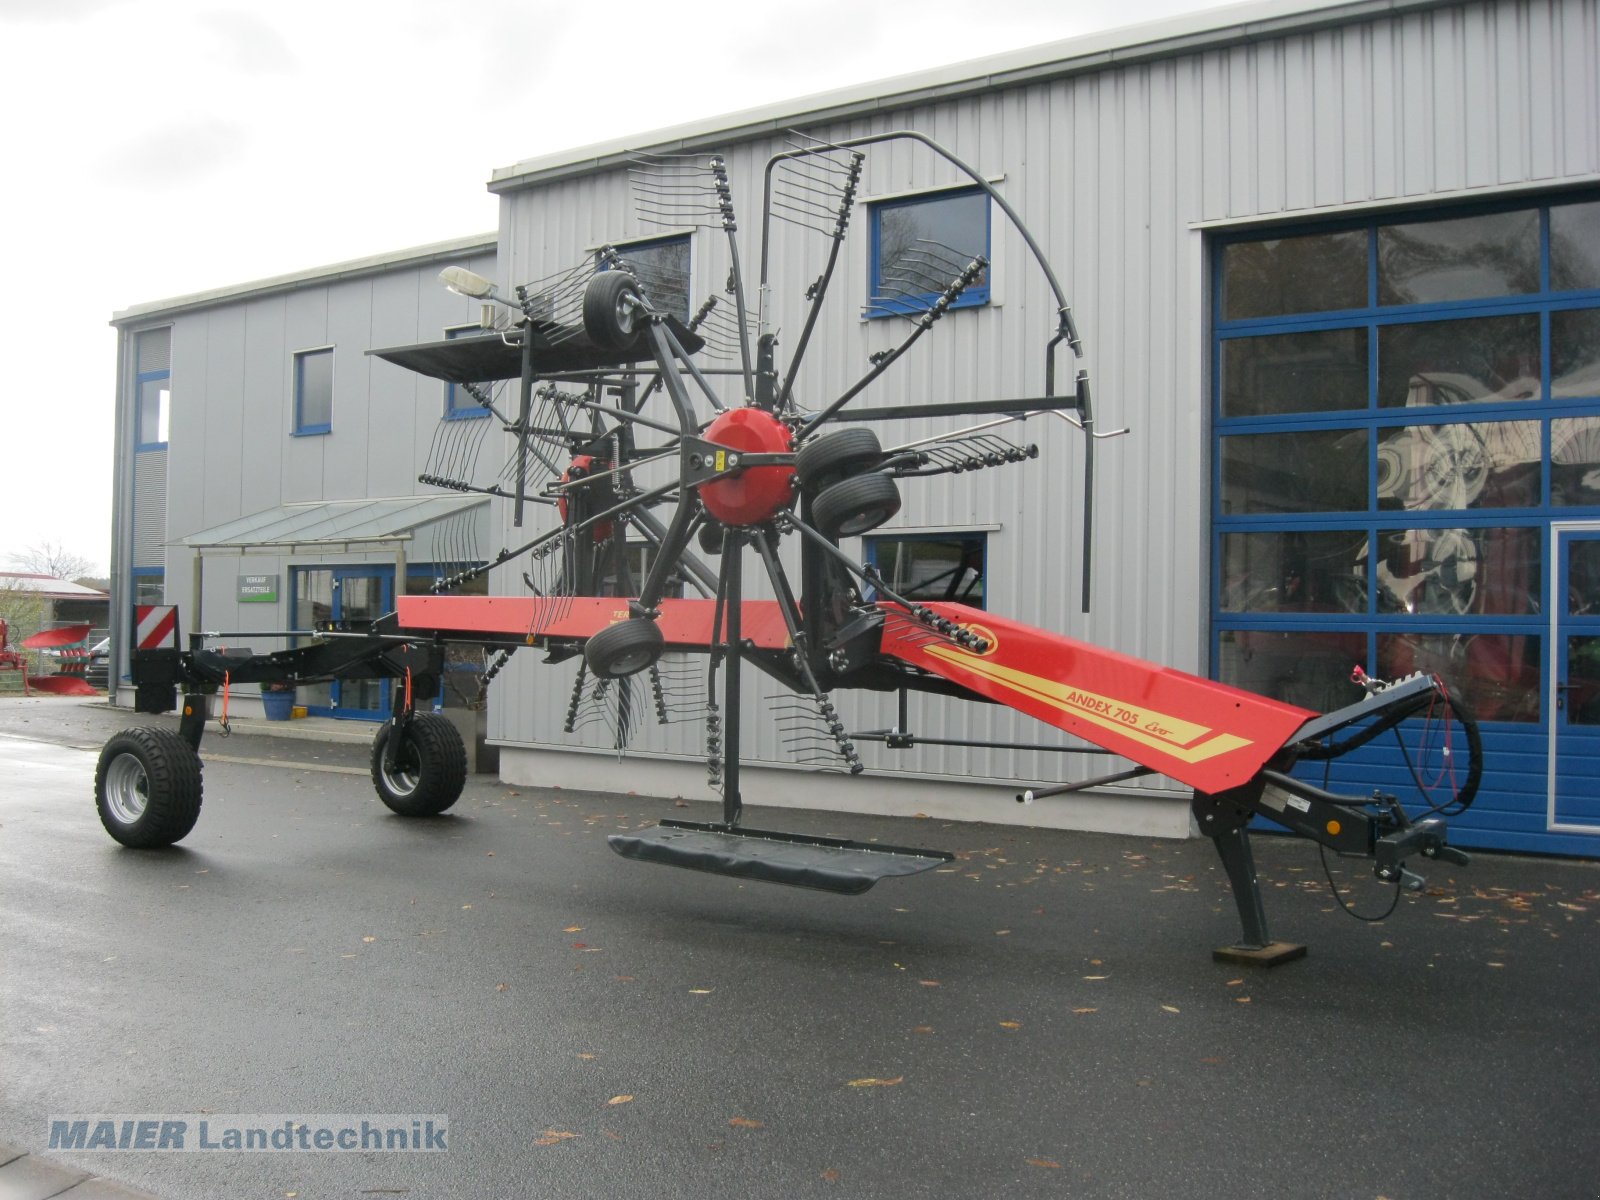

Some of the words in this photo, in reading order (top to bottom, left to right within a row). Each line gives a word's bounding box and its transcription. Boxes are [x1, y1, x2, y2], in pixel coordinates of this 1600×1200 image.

[1066, 691, 1112, 716] ANDEX
[1114, 708, 1139, 725] 705
[1144, 722, 1174, 736] Evo
